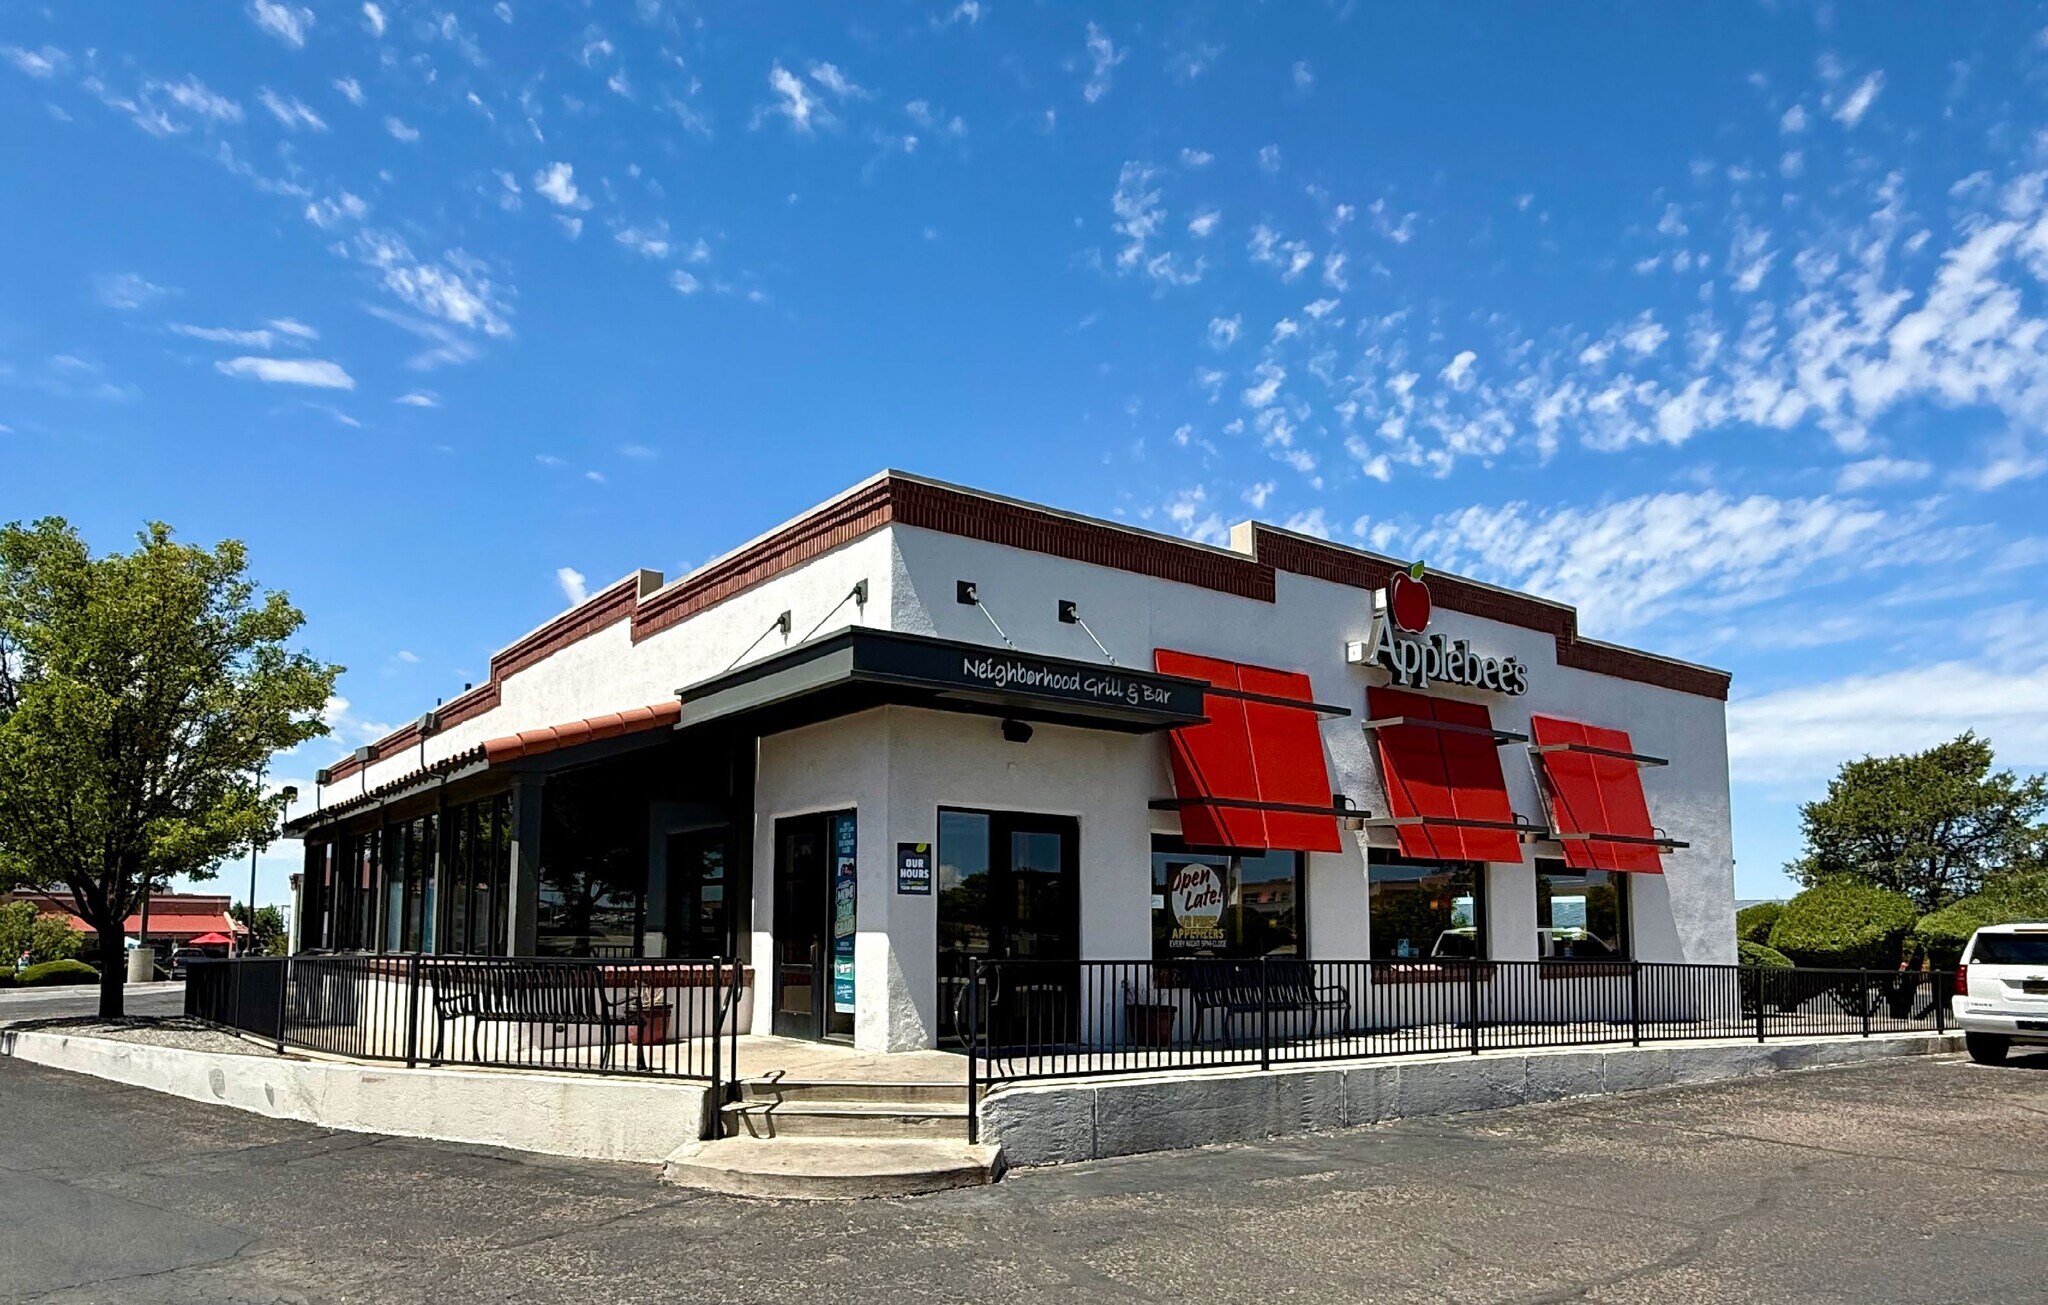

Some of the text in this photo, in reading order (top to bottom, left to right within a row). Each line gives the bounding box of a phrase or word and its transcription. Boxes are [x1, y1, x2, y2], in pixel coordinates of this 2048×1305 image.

[1367, 610, 1528, 696] Applebee's
[963, 658, 1173, 705] Neighborhood Grill & Bar
[900, 869, 930, 879] HOURS
[905, 858, 924, 868] OUR
[1171, 869, 1211, 896] Open
[1185, 883, 1221, 911] Late!
[1172, 928, 1224, 939] APPETIZERS
